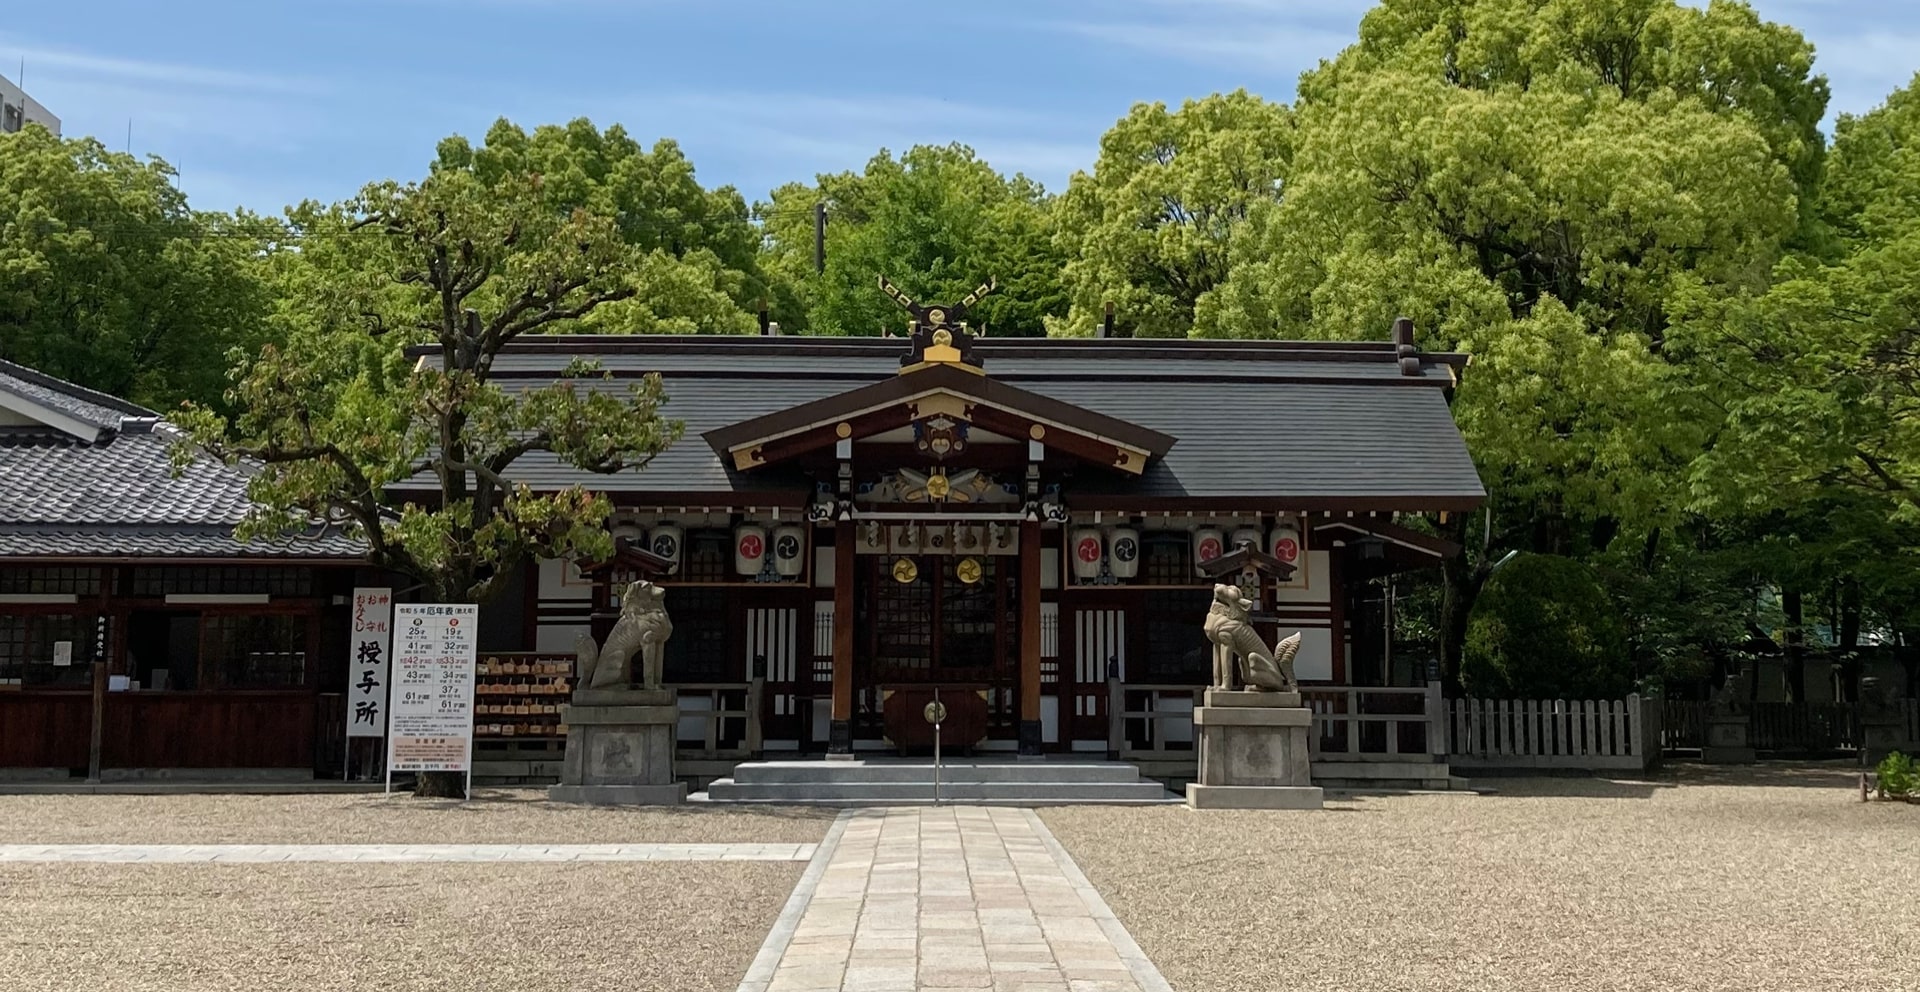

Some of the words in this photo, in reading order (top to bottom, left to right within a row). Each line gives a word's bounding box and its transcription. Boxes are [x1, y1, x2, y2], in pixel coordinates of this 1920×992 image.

[355, 595, 366, 632] おみくじ
[427, 607, 454, 616] 厄年表
[354, 640, 382, 726] 授与所
